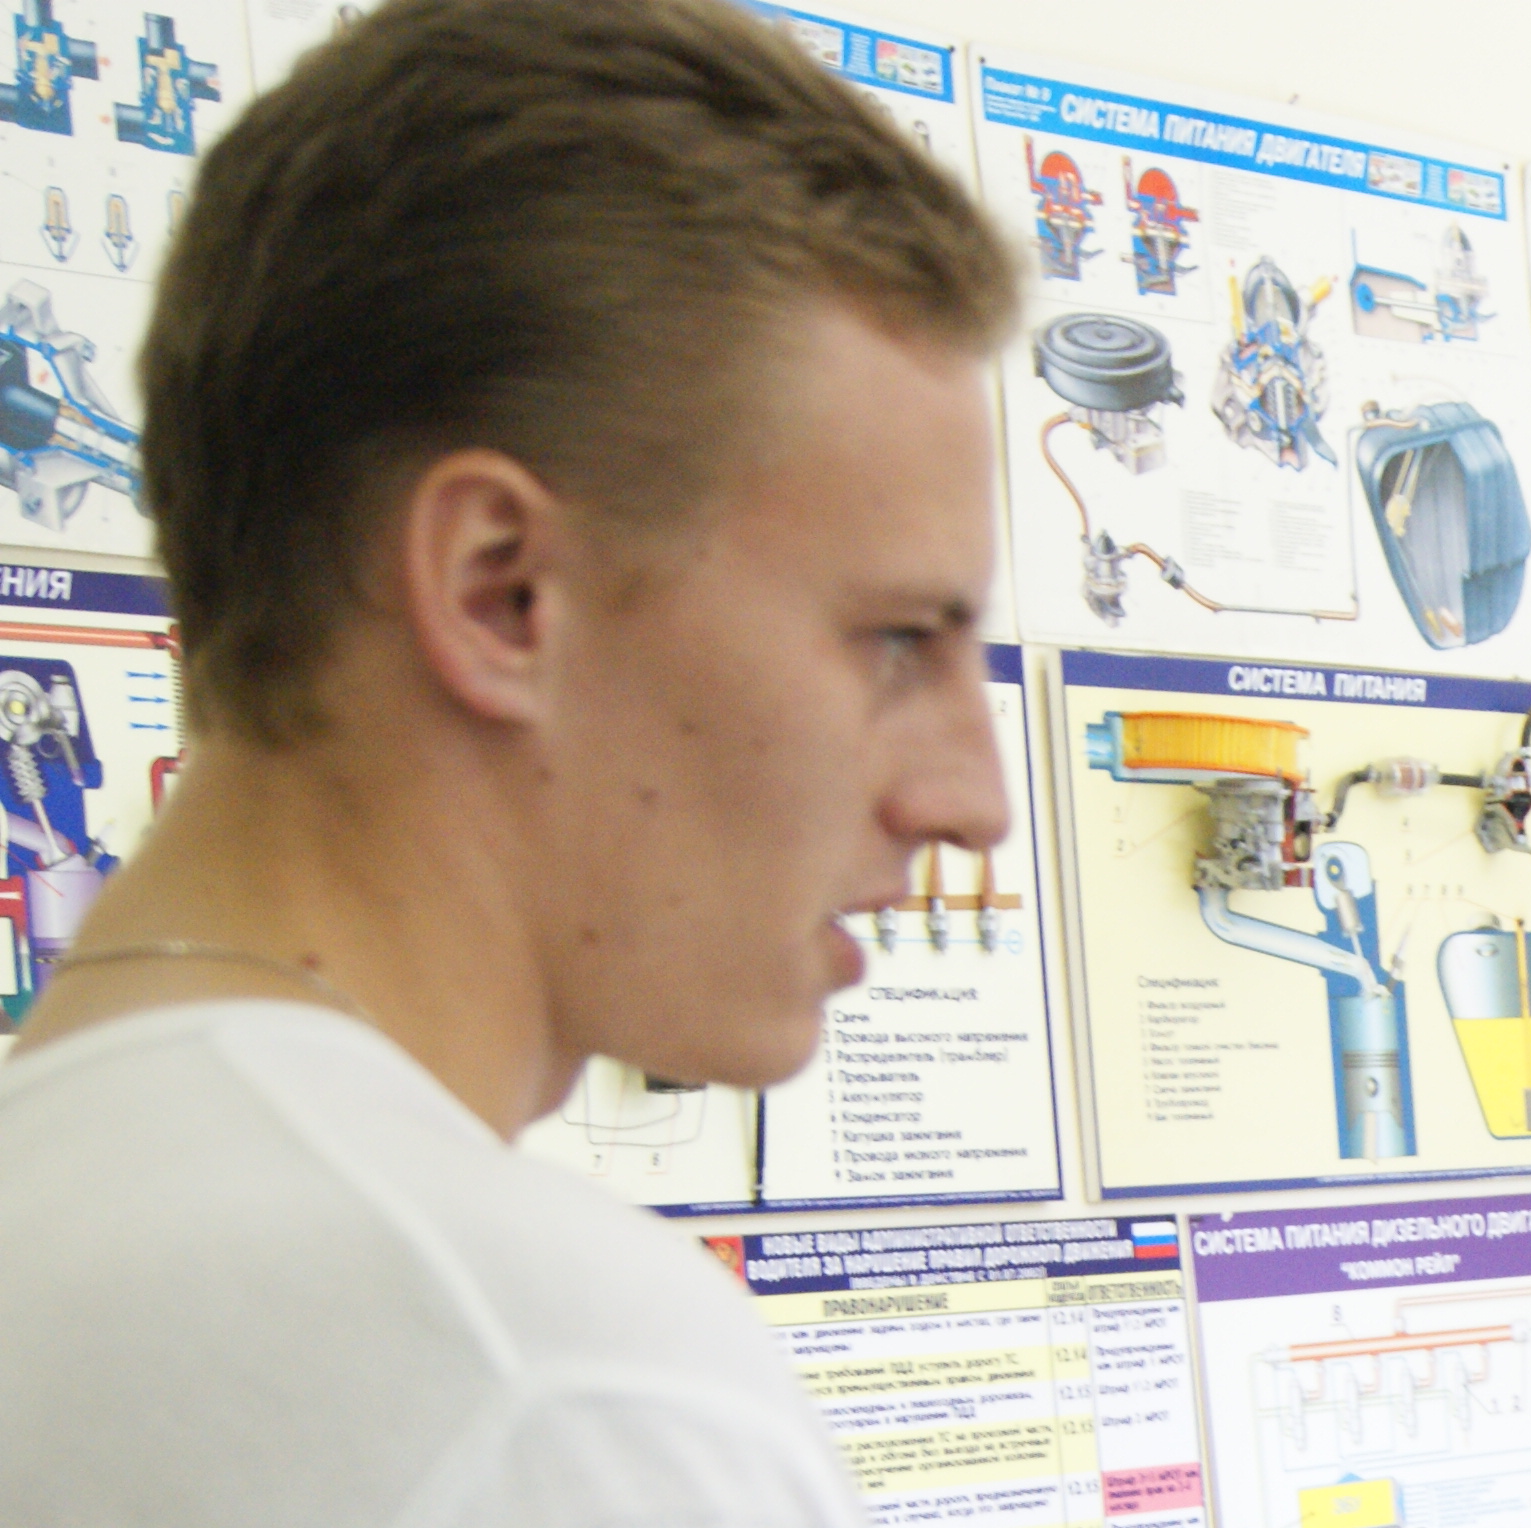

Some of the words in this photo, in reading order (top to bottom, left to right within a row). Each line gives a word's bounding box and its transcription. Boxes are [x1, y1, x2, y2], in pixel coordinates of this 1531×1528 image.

[1059, 93, 1160, 140] СИСТЕМА
[1162, 114, 1258, 158] ПИТАНИЯ
[1255, 133, 1366, 179] ДВИГАТЕЛЯ
[1227, 665, 1327, 698] СИСТЕМА
[1333, 673, 1427, 703] ПИТАНИЯ
[1193, 1227, 1284, 1257] СИСТЕМА
[1285, 1221, 1370, 1251] ПИТАНИЯ
[1371, 1213, 1486, 1248] ДИЗЕЛЬНОГО
[823, 1292, 949, 1318] ПРАВОНАРУШЕНИЕ
